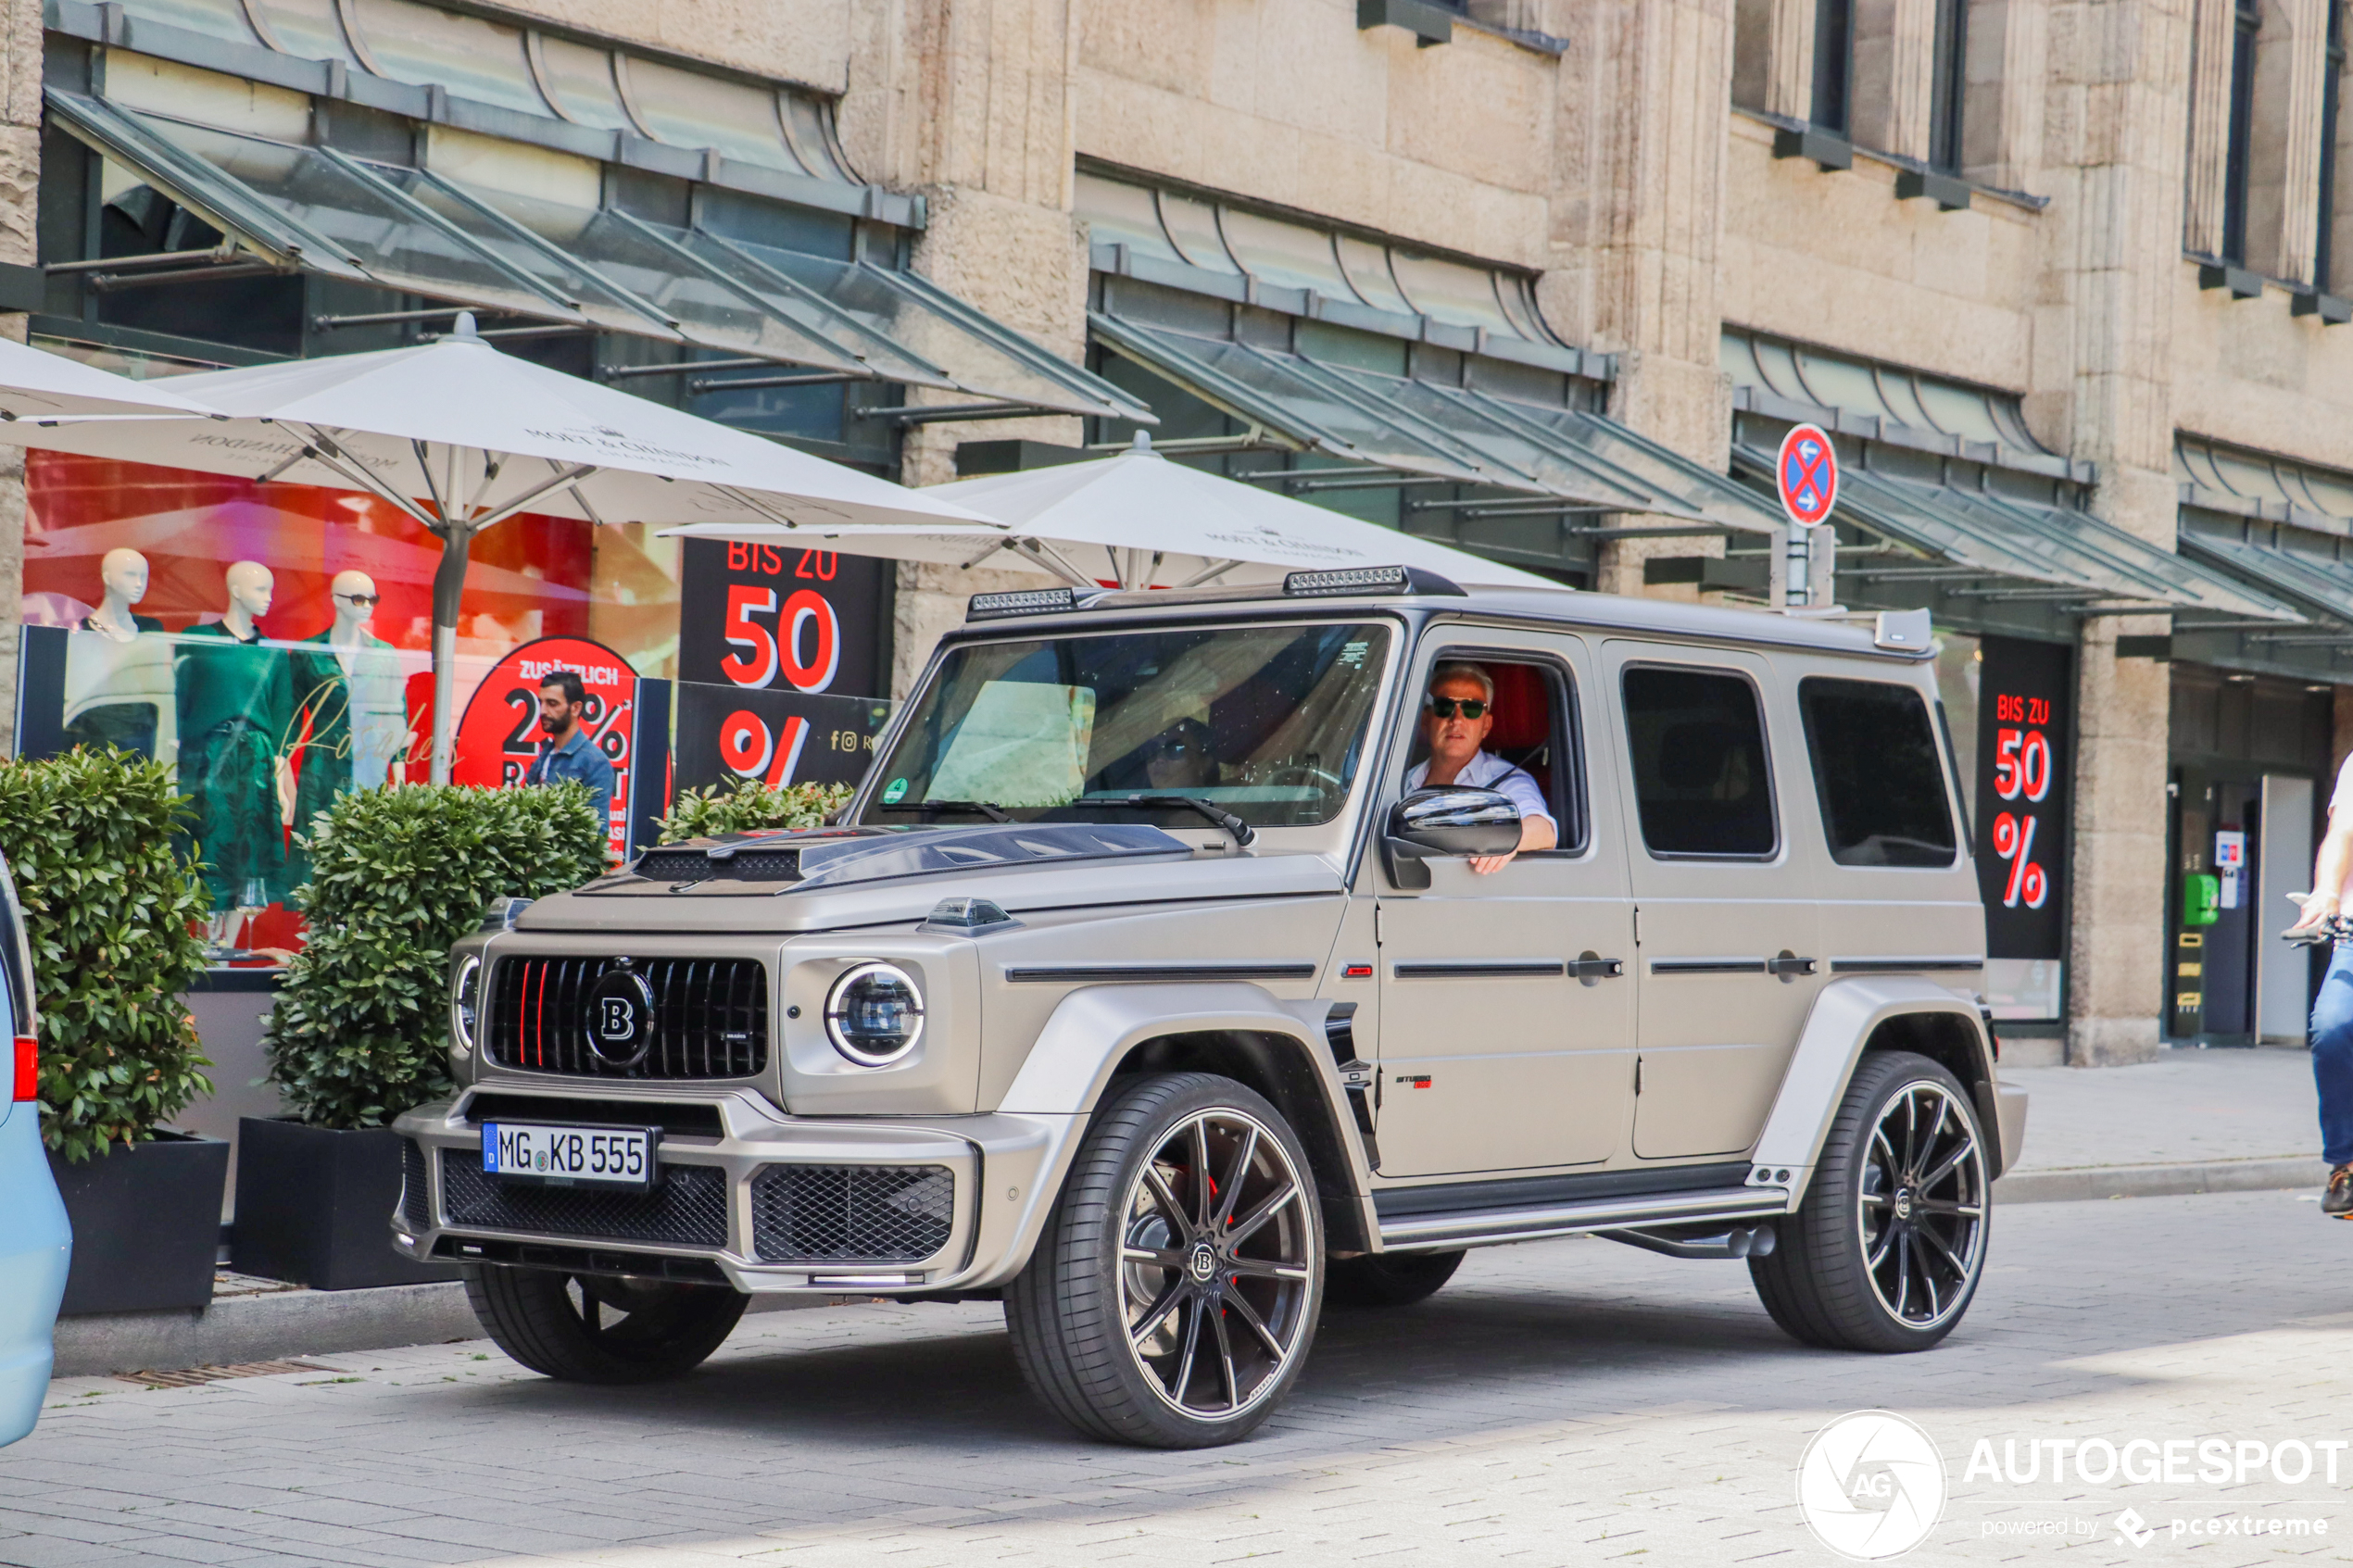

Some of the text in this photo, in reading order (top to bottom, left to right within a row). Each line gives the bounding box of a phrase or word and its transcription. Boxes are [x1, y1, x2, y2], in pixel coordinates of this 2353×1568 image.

[727, 540, 783, 575] BIS
[720, 584, 840, 694] 50
[1996, 694, 2050, 725] BIS ZU
[1994, 728, 2052, 803] 50
[1993, 811, 2048, 909] %
[601, 997, 634, 1039] B
[488, 1152, 495, 1164] D
[499, 1130, 643, 1175] MG KB 555
[1197, 1251, 1213, 1273] B
